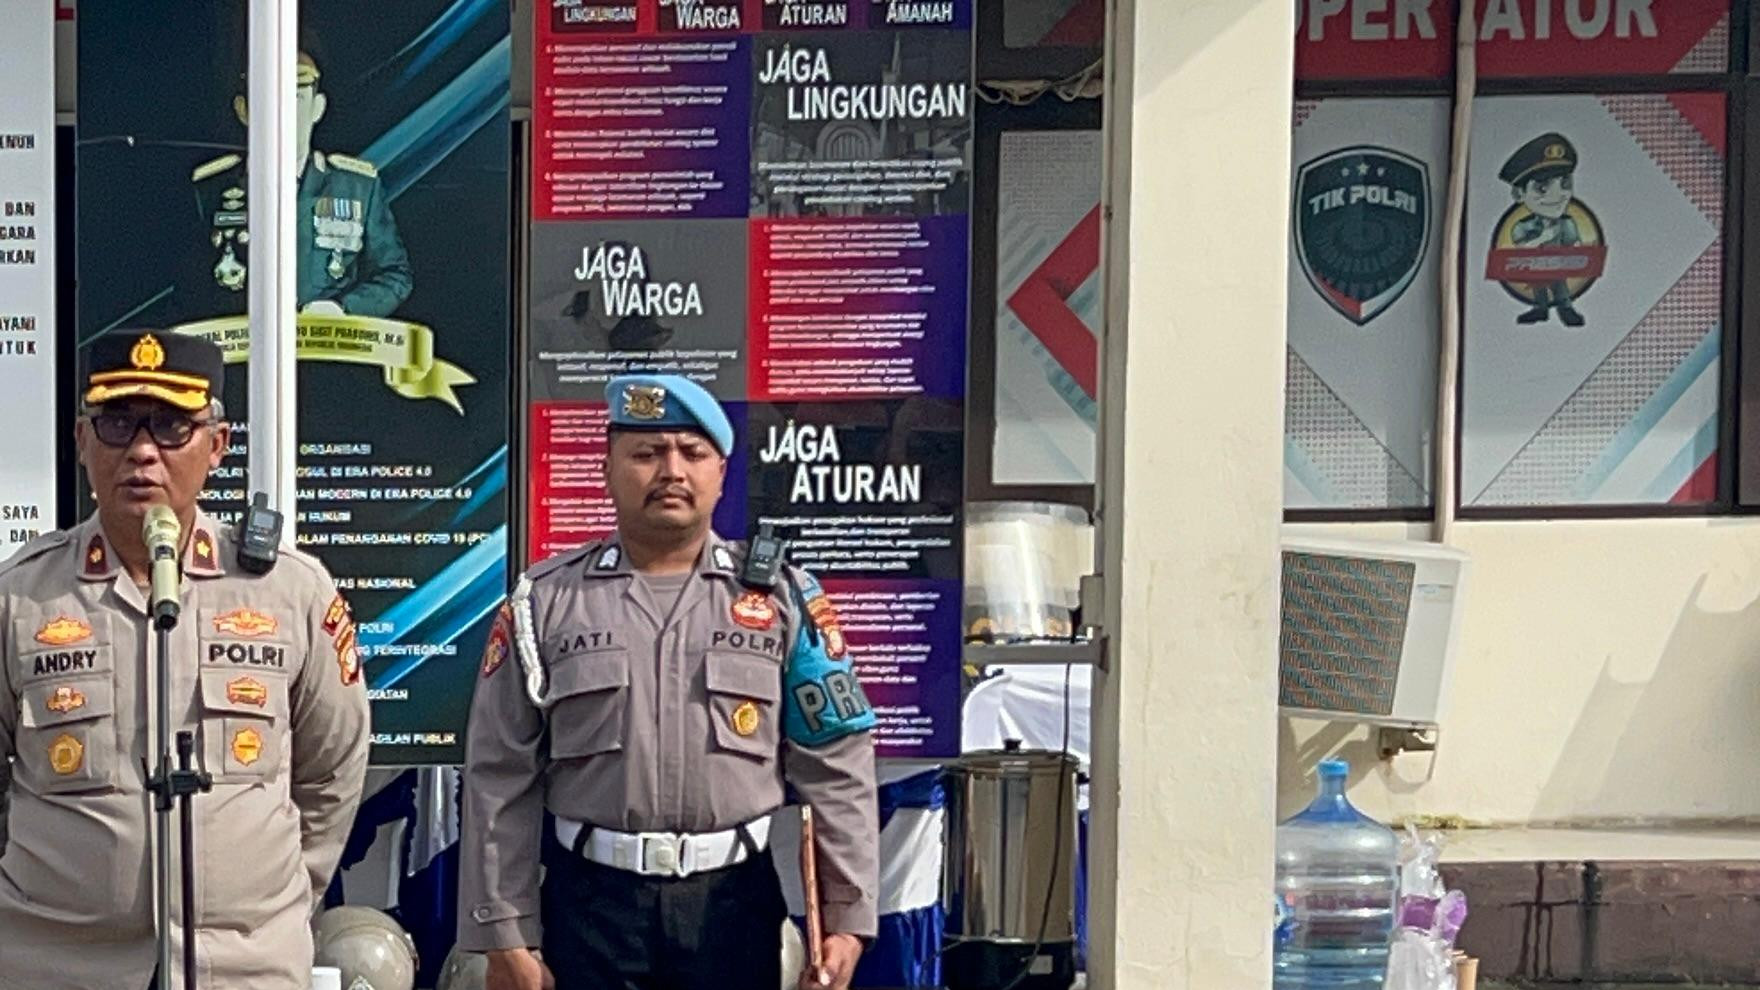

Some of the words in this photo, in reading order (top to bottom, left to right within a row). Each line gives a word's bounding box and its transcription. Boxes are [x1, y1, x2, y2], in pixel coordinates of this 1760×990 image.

[676, 4, 741, 29] WARGA
[780, 4, 847, 25] ATURAN
[886, 2, 954, 23] AMANAH
[1295, 0, 1658, 41] PERATOR
[758, 48, 831, 83] JAGA
[787, 85, 966, 120] LINGKUNGAN
[5, 202, 35, 216] DAN
[1308, 187, 1346, 215] TIK
[1350, 185, 1417, 215] POLRI
[574, 246, 646, 281] JAGA
[602, 281, 703, 316] WARGA
[760, 424, 839, 463] JAGA
[790, 464, 920, 503] ATURAN
[2, 505, 38, 520] SAYA
[33, 650, 97, 675] ANDRY
[208, 643, 285, 667] POLRI
[559, 632, 613, 652] JATI
[711, 631, 784, 656] POLRI
[794, 671, 868, 734] PR
